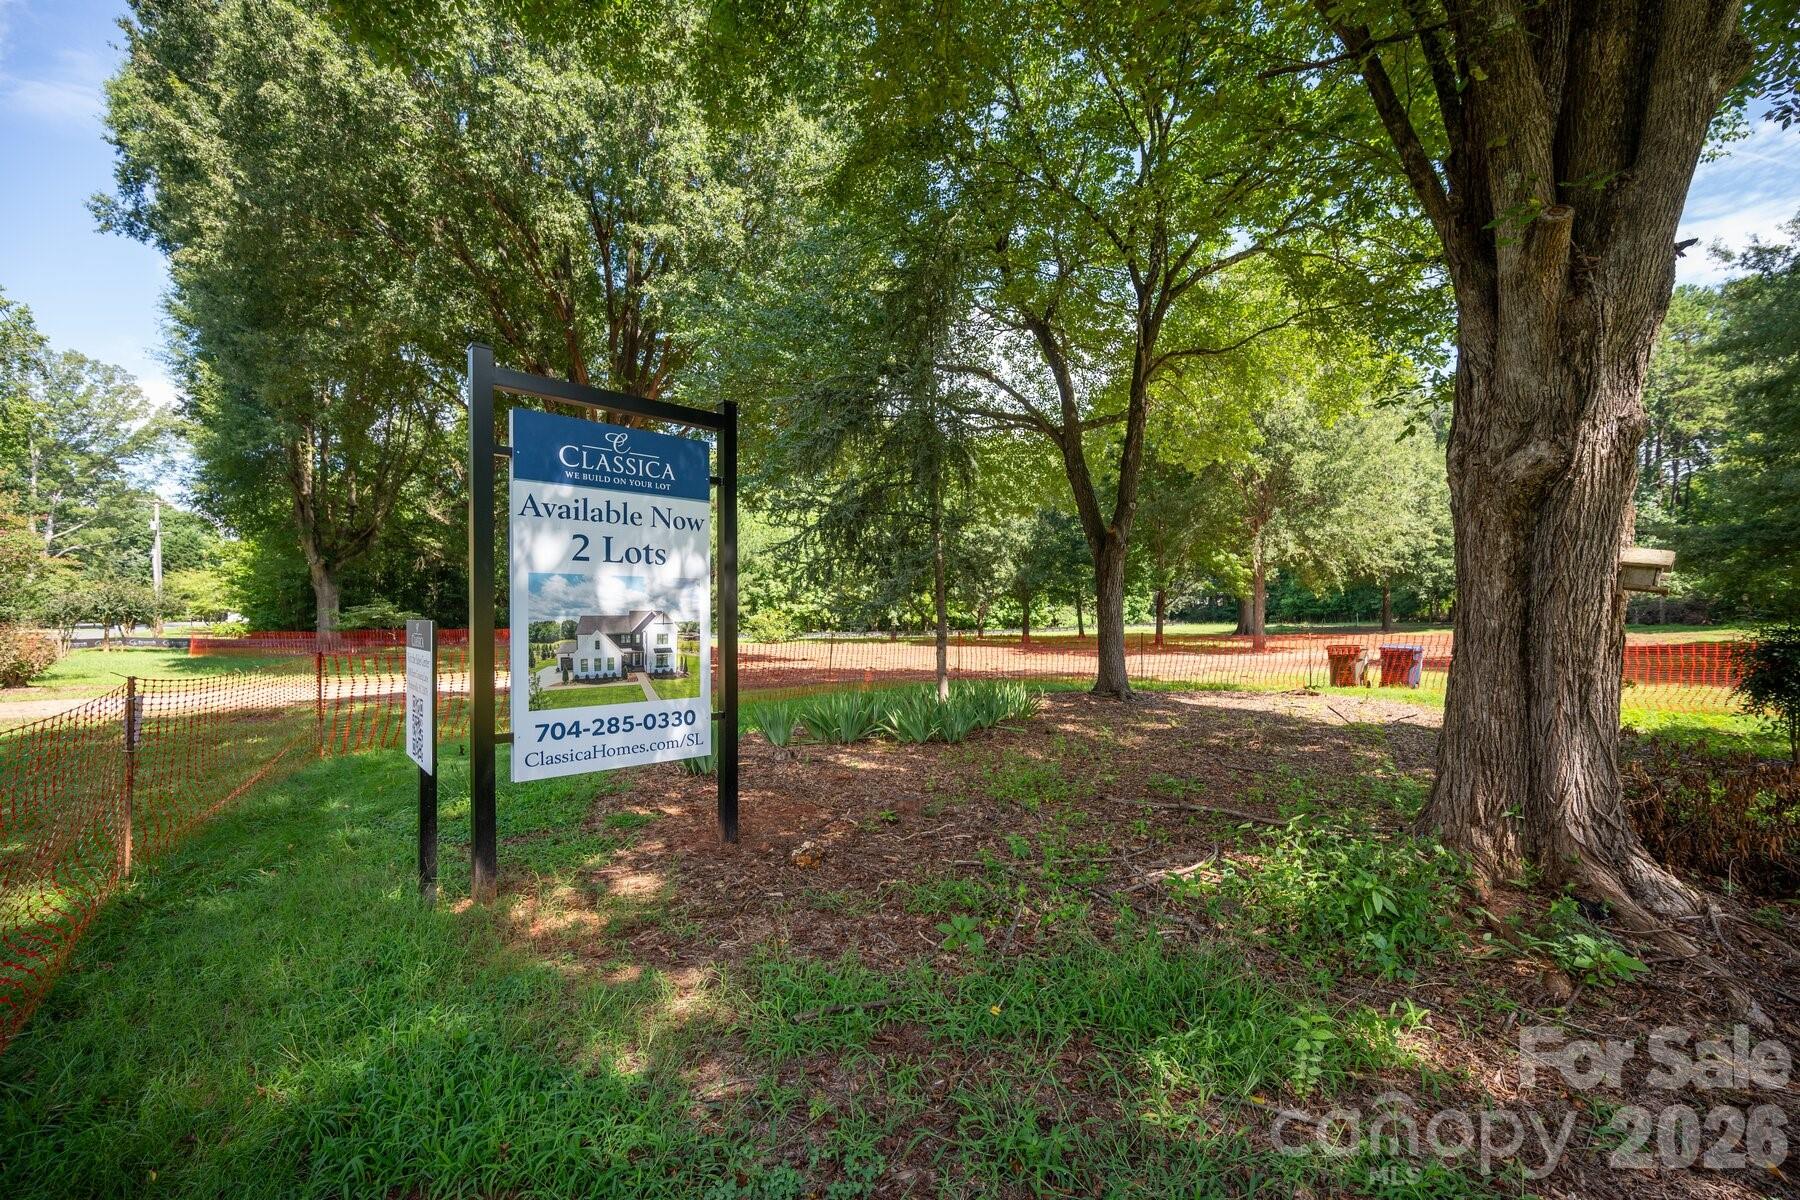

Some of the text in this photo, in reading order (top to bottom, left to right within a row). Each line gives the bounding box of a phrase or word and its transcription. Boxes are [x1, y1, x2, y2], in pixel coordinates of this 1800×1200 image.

[559, 445, 676, 480] CLASSICA
[565, 471, 672, 491] WE BUILD ON YOUR LOT
[518, 493, 705, 532] Available Now
[572, 533, 667, 565] 2 Lots
[535, 709, 696, 743] 704-285-0330
[524, 732, 704, 768] ClassicaHomes.com/SL
